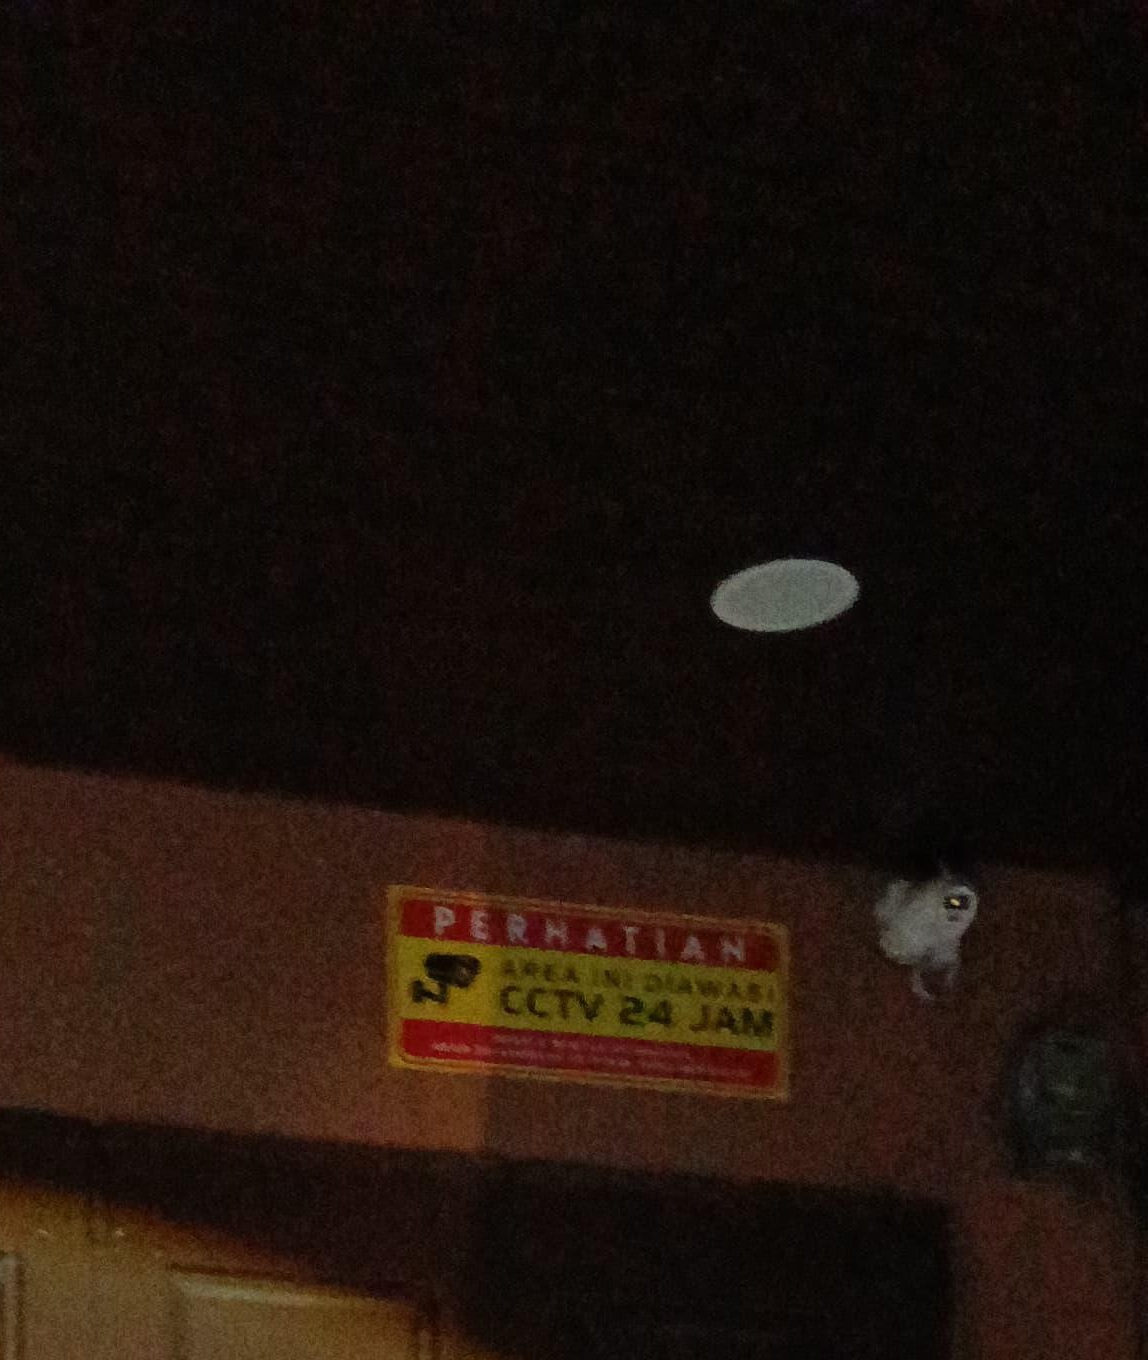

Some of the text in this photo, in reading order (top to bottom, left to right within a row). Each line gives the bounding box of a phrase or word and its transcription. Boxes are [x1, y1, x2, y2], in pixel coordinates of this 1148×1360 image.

[433, 905, 746, 962] PERHATIAN
[499, 985, 775, 1038] CCTV 24 JAM
